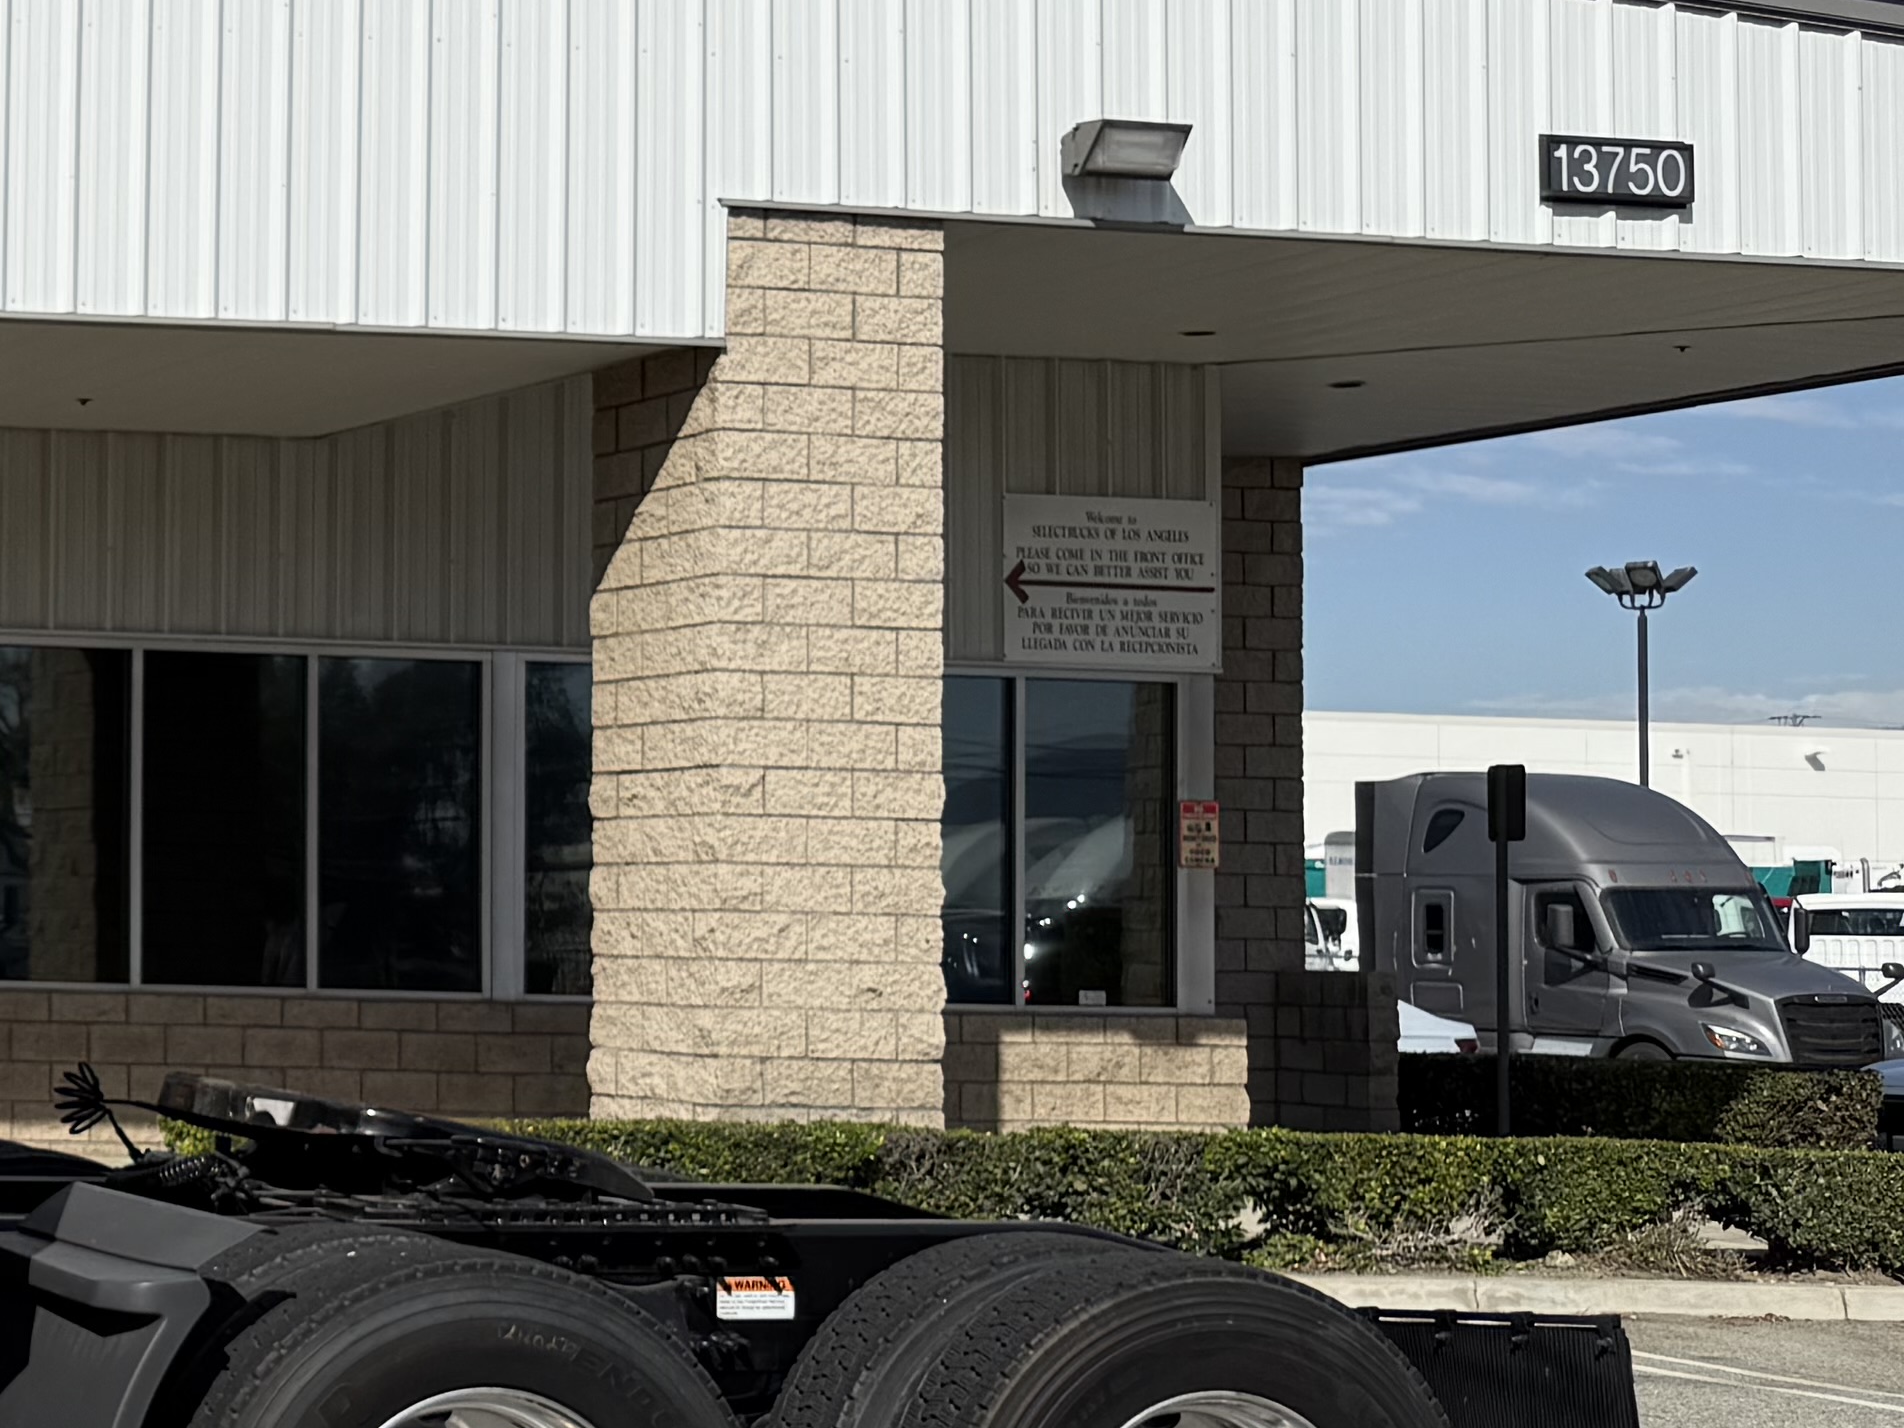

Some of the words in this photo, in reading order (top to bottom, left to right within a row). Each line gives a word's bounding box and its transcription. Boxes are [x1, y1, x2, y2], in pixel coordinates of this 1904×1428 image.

[1553, 143, 1686, 197] 13750
[1086, 511, 1123, 524] Welcome
[1128, 515, 1136, 525] to
[1033, 525, 1099, 540] SELECTRUCKS
[1105, 528, 1116, 540] OF
[1122, 528, 1140, 541] LOS
[1146, 529, 1189, 543] ANGELES
[1016, 546, 1050, 559] PLEASE
[1056, 548, 1084, 561] COME
[1091, 549, 1102, 561] IN
[1109, 550, 1127, 562] THE
[1134, 550, 1166, 565] FRONT
[1172, 552, 1204, 566] OFFICE
[1027, 562, 1040, 574] SO
[1046, 564, 1061, 575] WE
[1067, 564, 1088, 576] CAN
[1094, 565, 1132, 577] BETTER
[1138, 566, 1168, 579] ASSIST
[1174, 567, 1194, 580] YOU
[1066, 592, 1117, 606] Bienvenidos
[1133, 595, 1157, 607] todos
[1017, 606, 1045, 619] PARA
[1099, 608, 1116, 621] UN
[1120, 610, 1153, 624] MEJOR
[1159, 610, 1204, 624] SERVICIO
[1033, 622, 1053, 635] POR
[1059, 623, 1090, 636] FAVOR
[1096, 624, 1107, 636] DE
[1114, 625, 1171, 639] ANUNCIAR
[1176, 626, 1189, 640] SU
[1022, 637, 1067, 651] LLEGADA
[1073, 639, 1095, 652] CON
[1101, 640, 1114, 652] LA
[1120, 640, 1198, 655] RECEPCIONISTA
